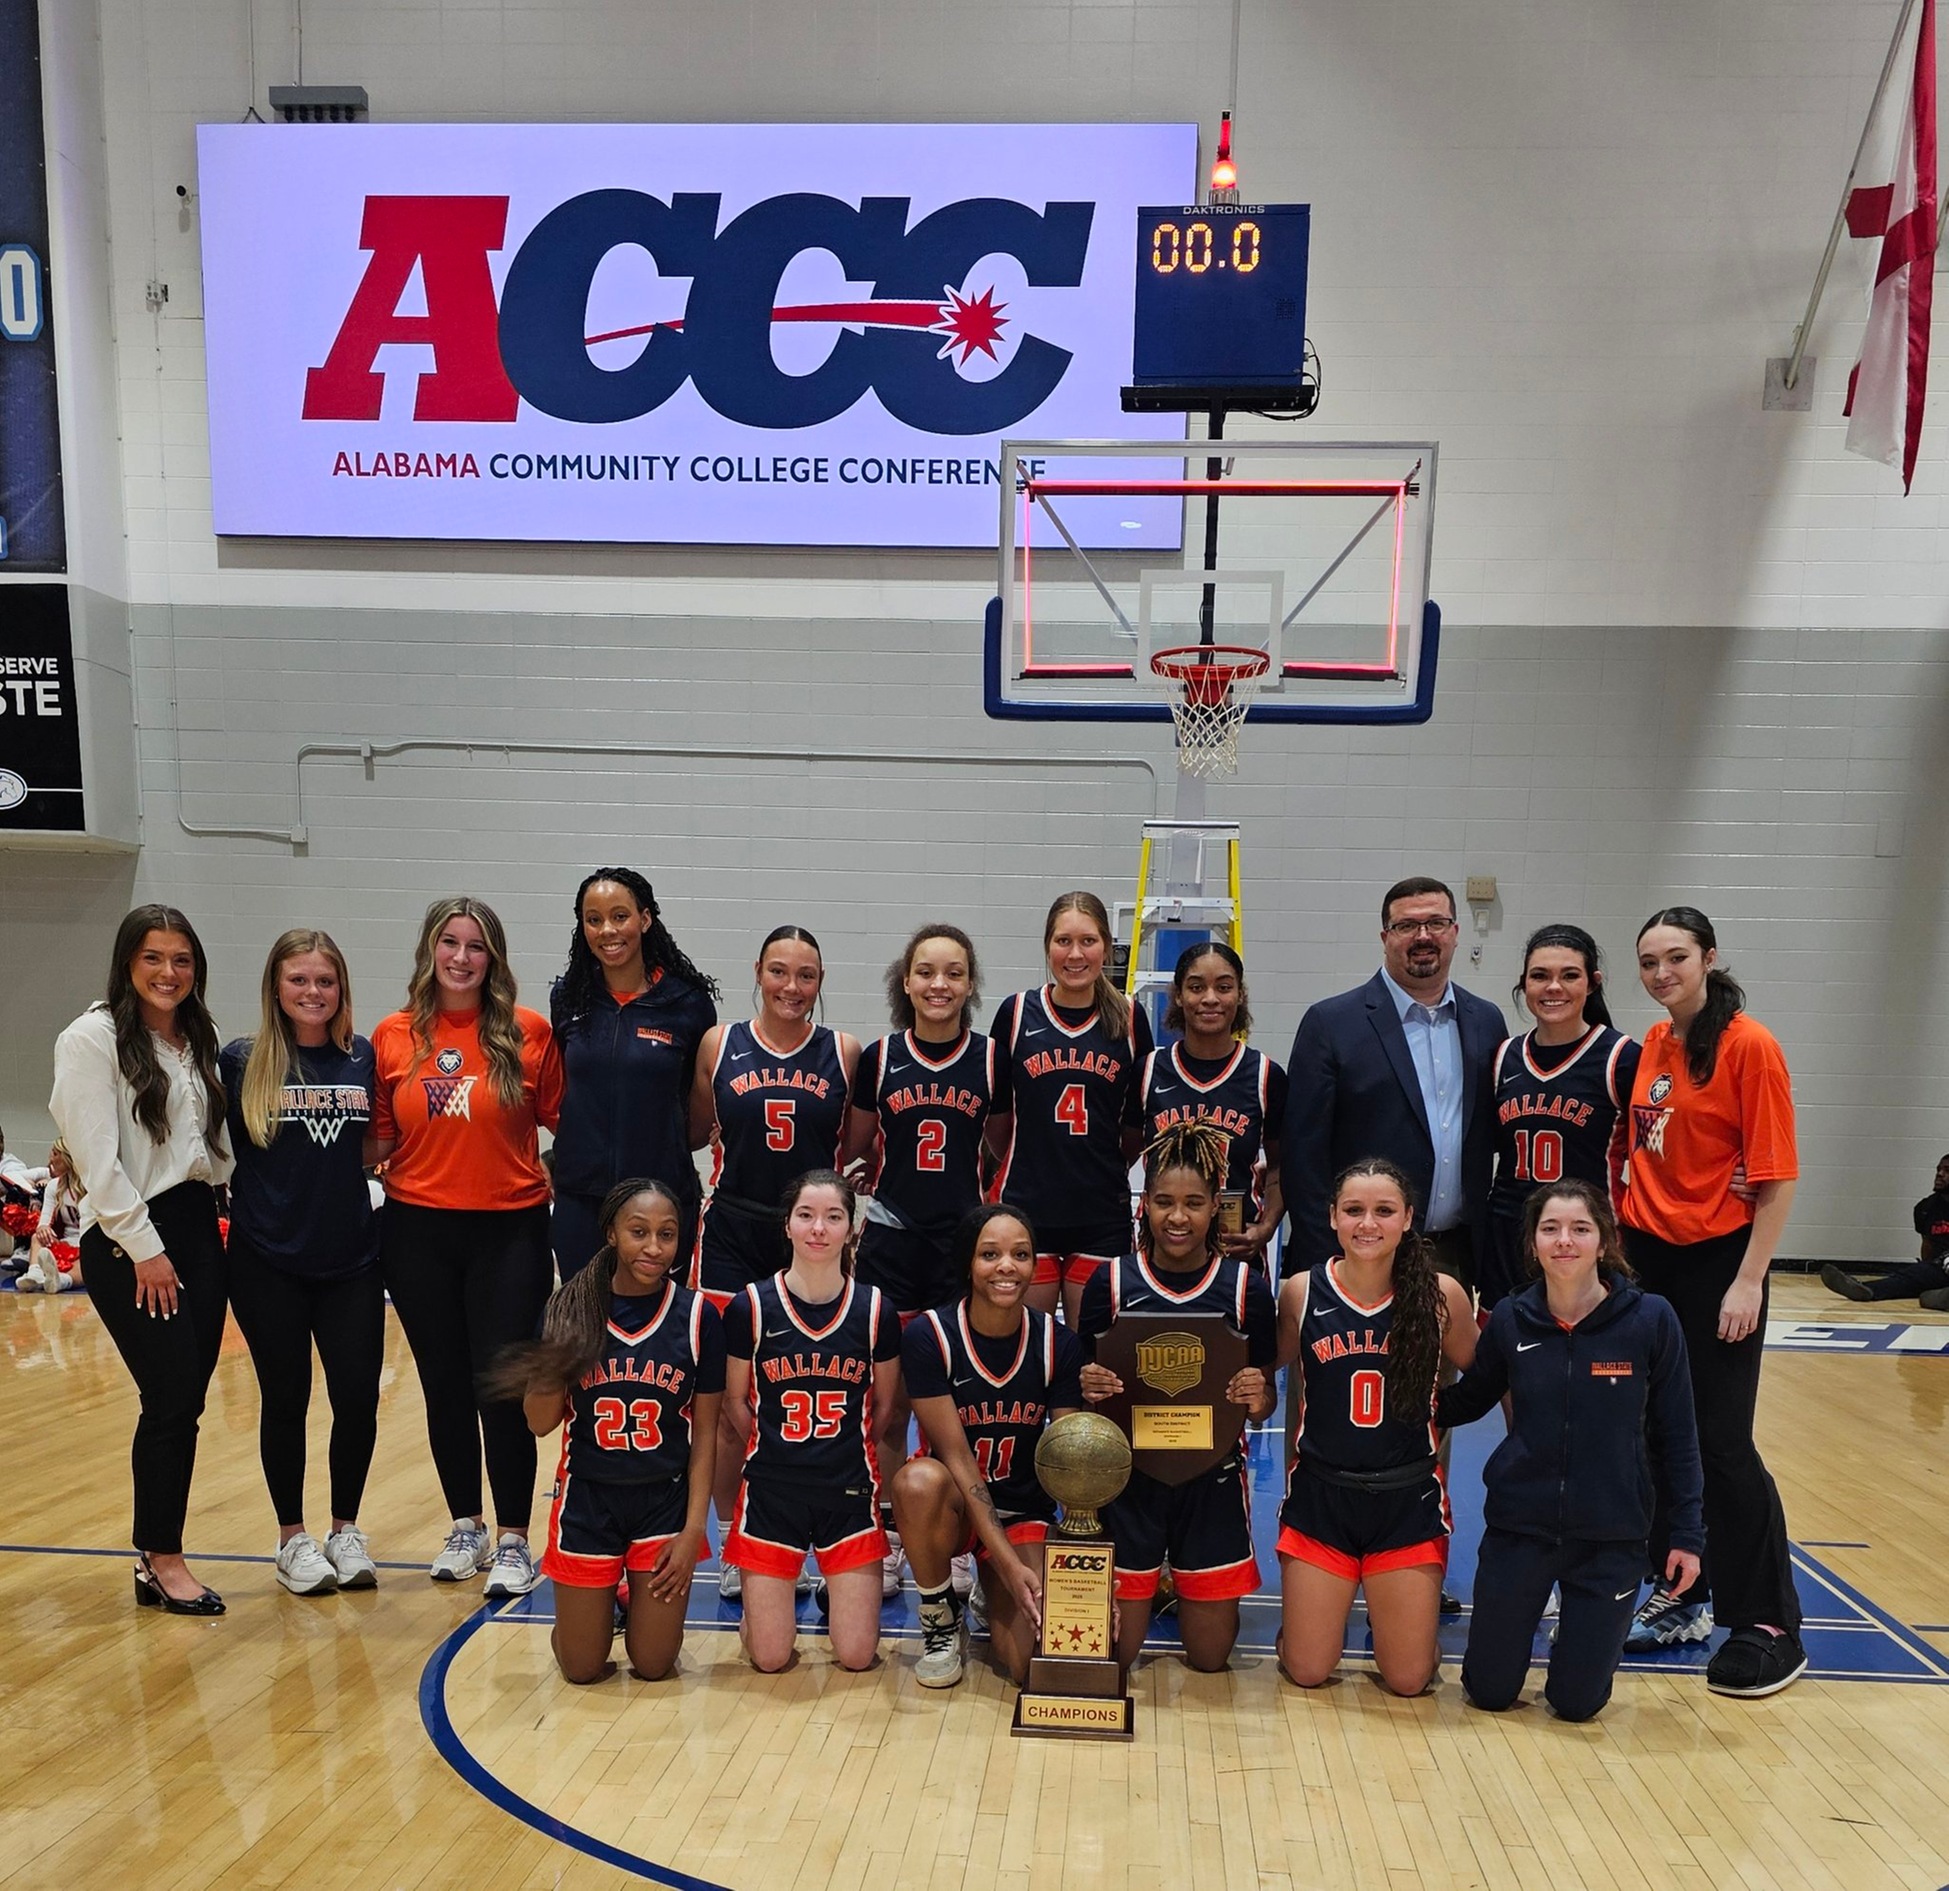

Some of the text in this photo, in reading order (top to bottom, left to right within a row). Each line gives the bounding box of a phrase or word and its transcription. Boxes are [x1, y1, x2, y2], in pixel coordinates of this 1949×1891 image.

[1182, 205, 1266, 215] DAKTRONICS
[1152, 221, 1261, 273] 00.0
[301, 188, 1095, 435] ACCC
[332, 451, 481, 479] ALABAMA
[489, 453, 680, 481] COMMUNITY
[689, 455, 830, 484] COLLEGE
[0, 680, 62, 716] TE
[1022, 1047, 1122, 1083] WALLACE
[279, 1088, 370, 1112] ALLACE STATE
[729, 1067, 831, 1100] WALLACE
[885, 1083, 983, 1118] WALLACE
[764, 1099, 796, 1152] 5
[1054, 1084, 1089, 1136] 4
[1498, 1092, 1595, 1128] WALLACE
[916, 1119, 947, 1172] 2
[1514, 1129, 1563, 1183] 10
[1137, 1344, 1203, 1375] NJCAA
[1311, 1329, 1391, 1364] WALLA
[579, 1357, 686, 1395] WALLACE
[762, 1352, 867, 1385] WALLACE
[780, 1389, 848, 1443] 35
[1350, 1369, 1385, 1429] 0
[594, 1396, 663, 1451] 23
[974, 1435, 1016, 1483] 11
[1050, 1554, 1107, 1572] ACCC
[1027, 1706, 1118, 1722] CHAMPIONS
